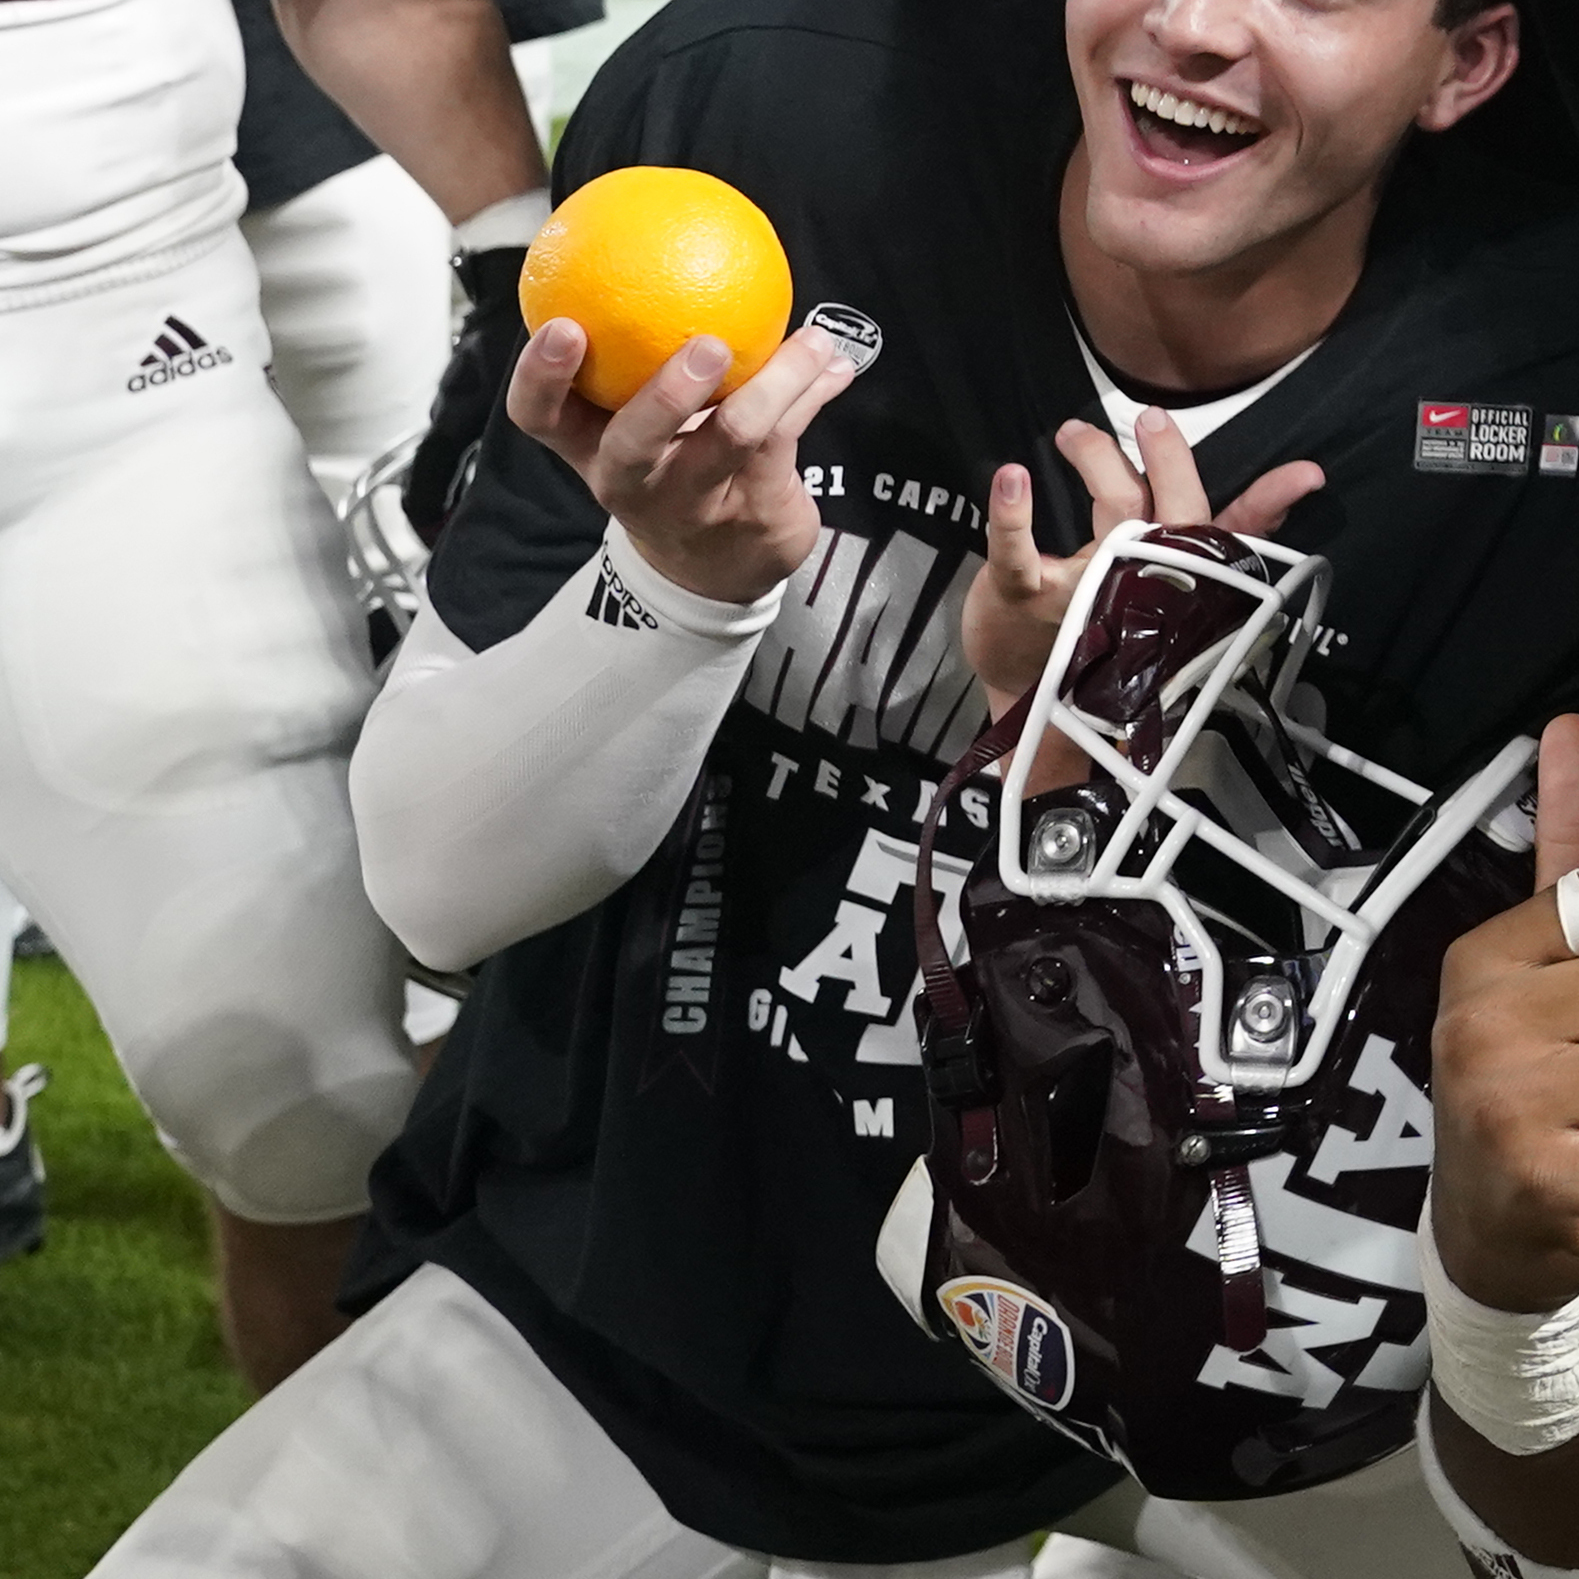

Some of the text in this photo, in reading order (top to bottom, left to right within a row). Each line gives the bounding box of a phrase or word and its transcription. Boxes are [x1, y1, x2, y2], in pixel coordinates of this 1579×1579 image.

[126, 344, 234, 394] adidas
[1470, 424, 1527, 445] LOCKER
[1471, 407, 1530, 426] OFFICIAL
[1469, 444, 1526, 463] ROOM
[872, 472, 990, 533] CAPIT
[601, 540, 659, 631] adida
[661, 773, 734, 1034] CHAMPIONS
